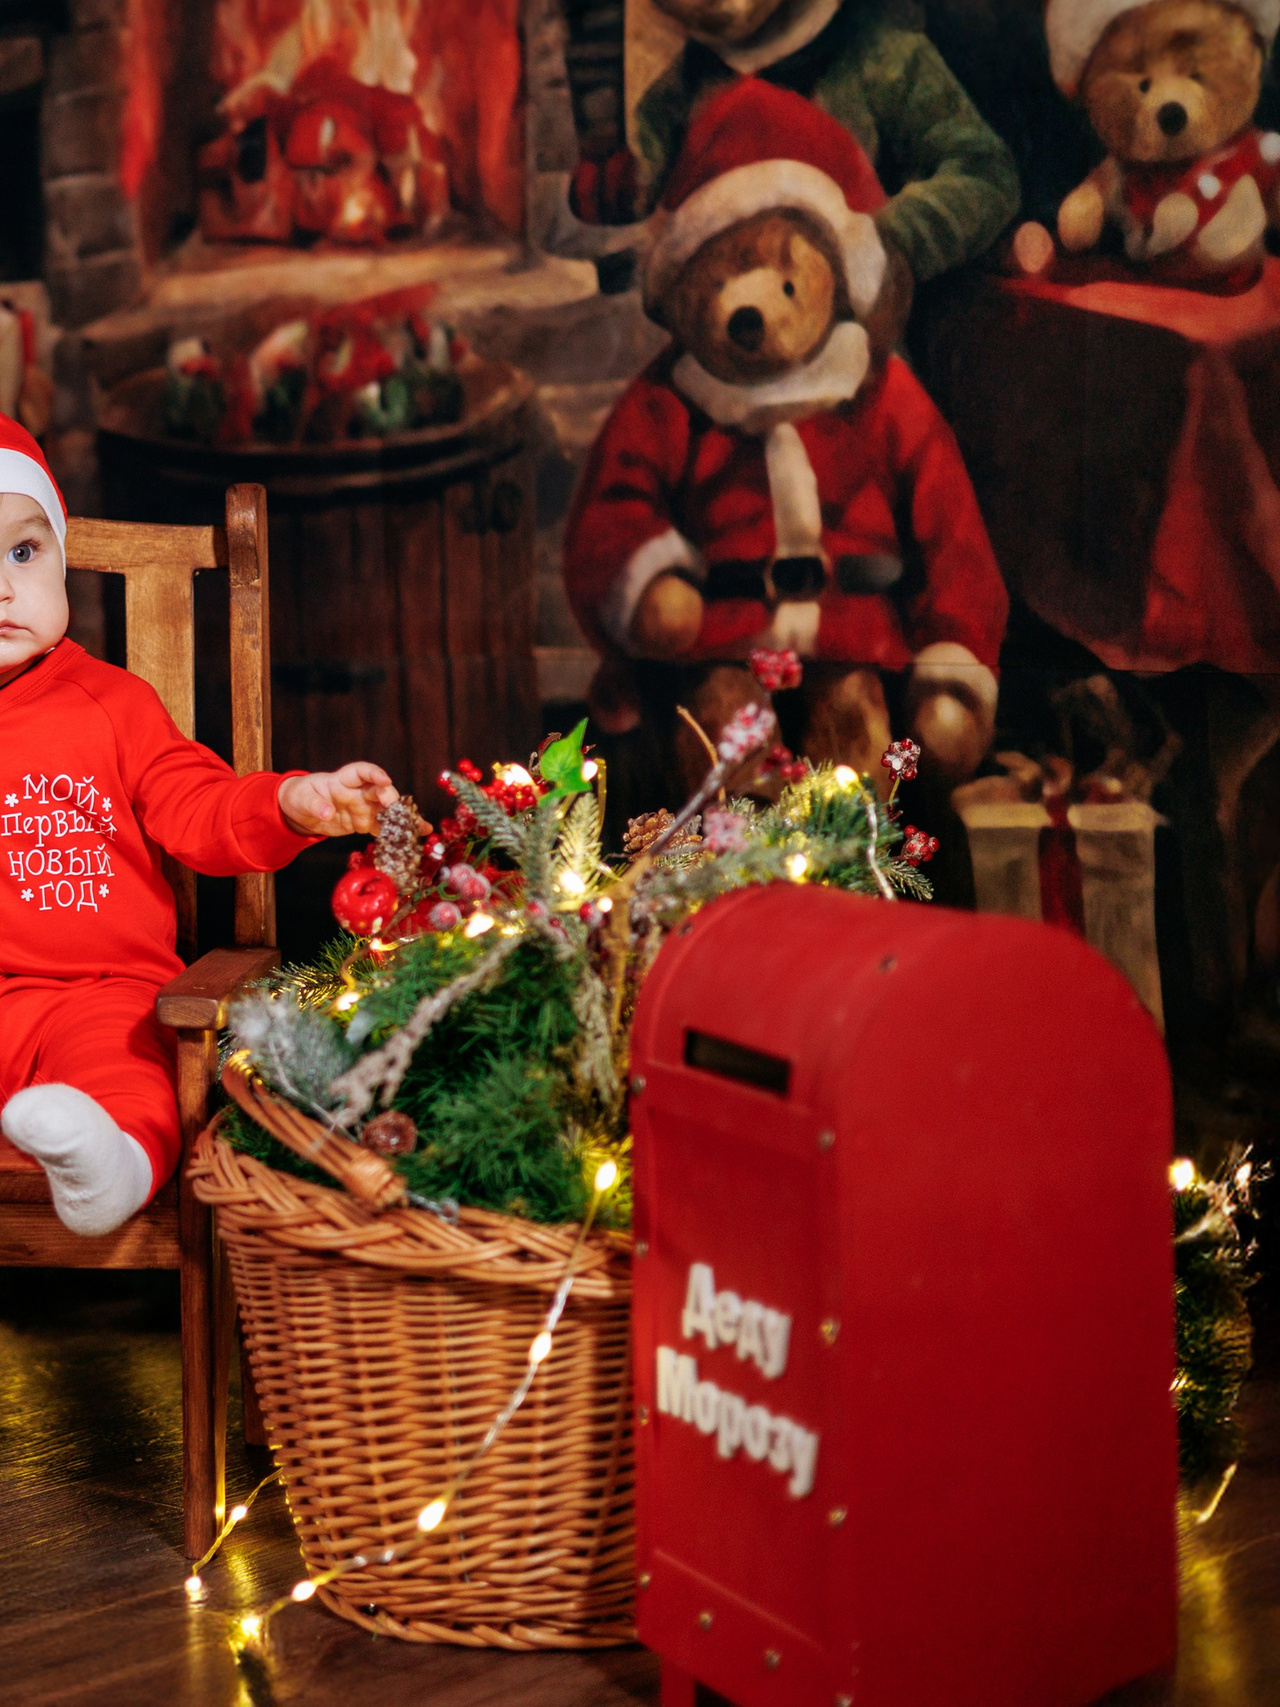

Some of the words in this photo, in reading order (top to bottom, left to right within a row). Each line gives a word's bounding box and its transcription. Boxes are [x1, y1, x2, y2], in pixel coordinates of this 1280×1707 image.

[23, 774, 99, 814] МОЙ
[7, 843, 115, 881] НОВЫЙ
[39, 880, 98, 913] ГОД
[681, 1262, 792, 1379] Деду
[656, 1345, 819, 1498] Морозу
